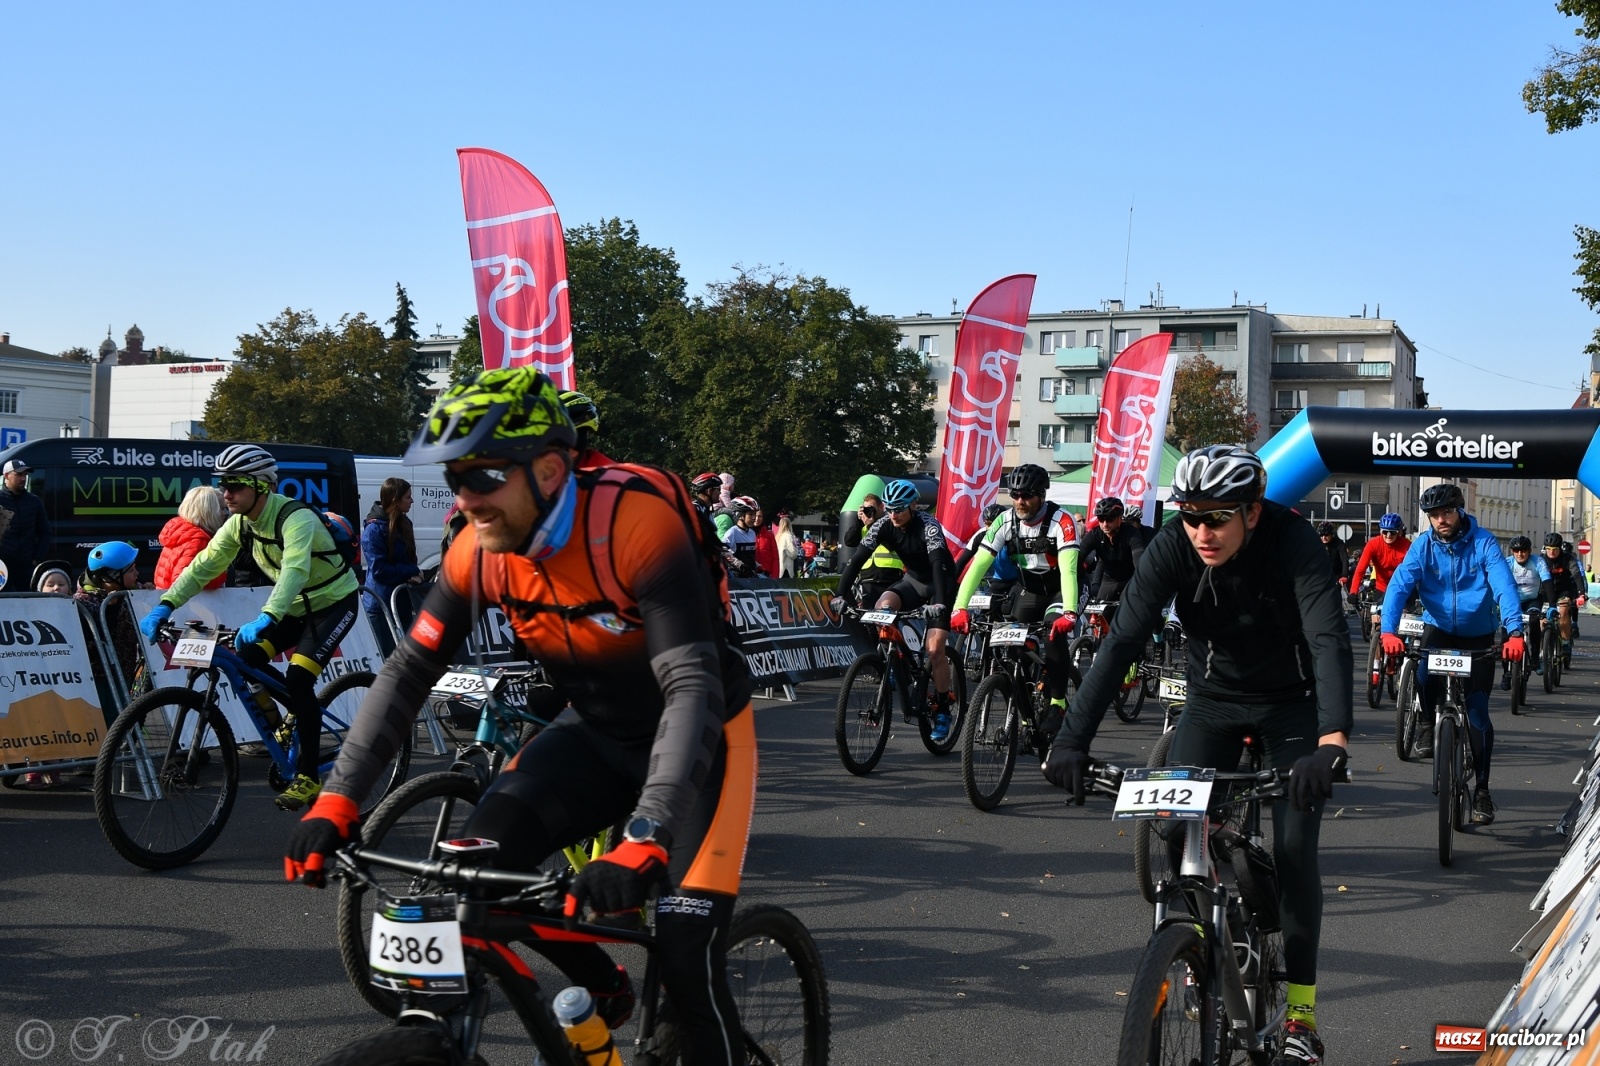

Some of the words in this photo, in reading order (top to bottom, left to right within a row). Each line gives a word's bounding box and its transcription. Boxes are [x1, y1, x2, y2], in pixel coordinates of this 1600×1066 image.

[1372, 432, 1428, 457] bike
[1435, 434, 1523, 459] atelier
[113, 448, 155, 466] bike
[161, 451, 218, 468] atelie
[1330, 495, 1342, 510] 0
[868, 613, 890, 621] 3237
[1405, 622, 1425, 630] 2680
[315, 610, 355, 661] AIRBIKE
[997, 630, 1021, 639] 2494
[0, 650, 39, 658] ziekolwiek
[41, 649, 71, 658] jedziesz
[179, 643, 207, 656] 2748
[1435, 657, 1463, 667] 3198
[444, 677, 485, 692] 2339
[1133, 788, 1193, 805] 1142
[380, 932, 443, 965] 2386
